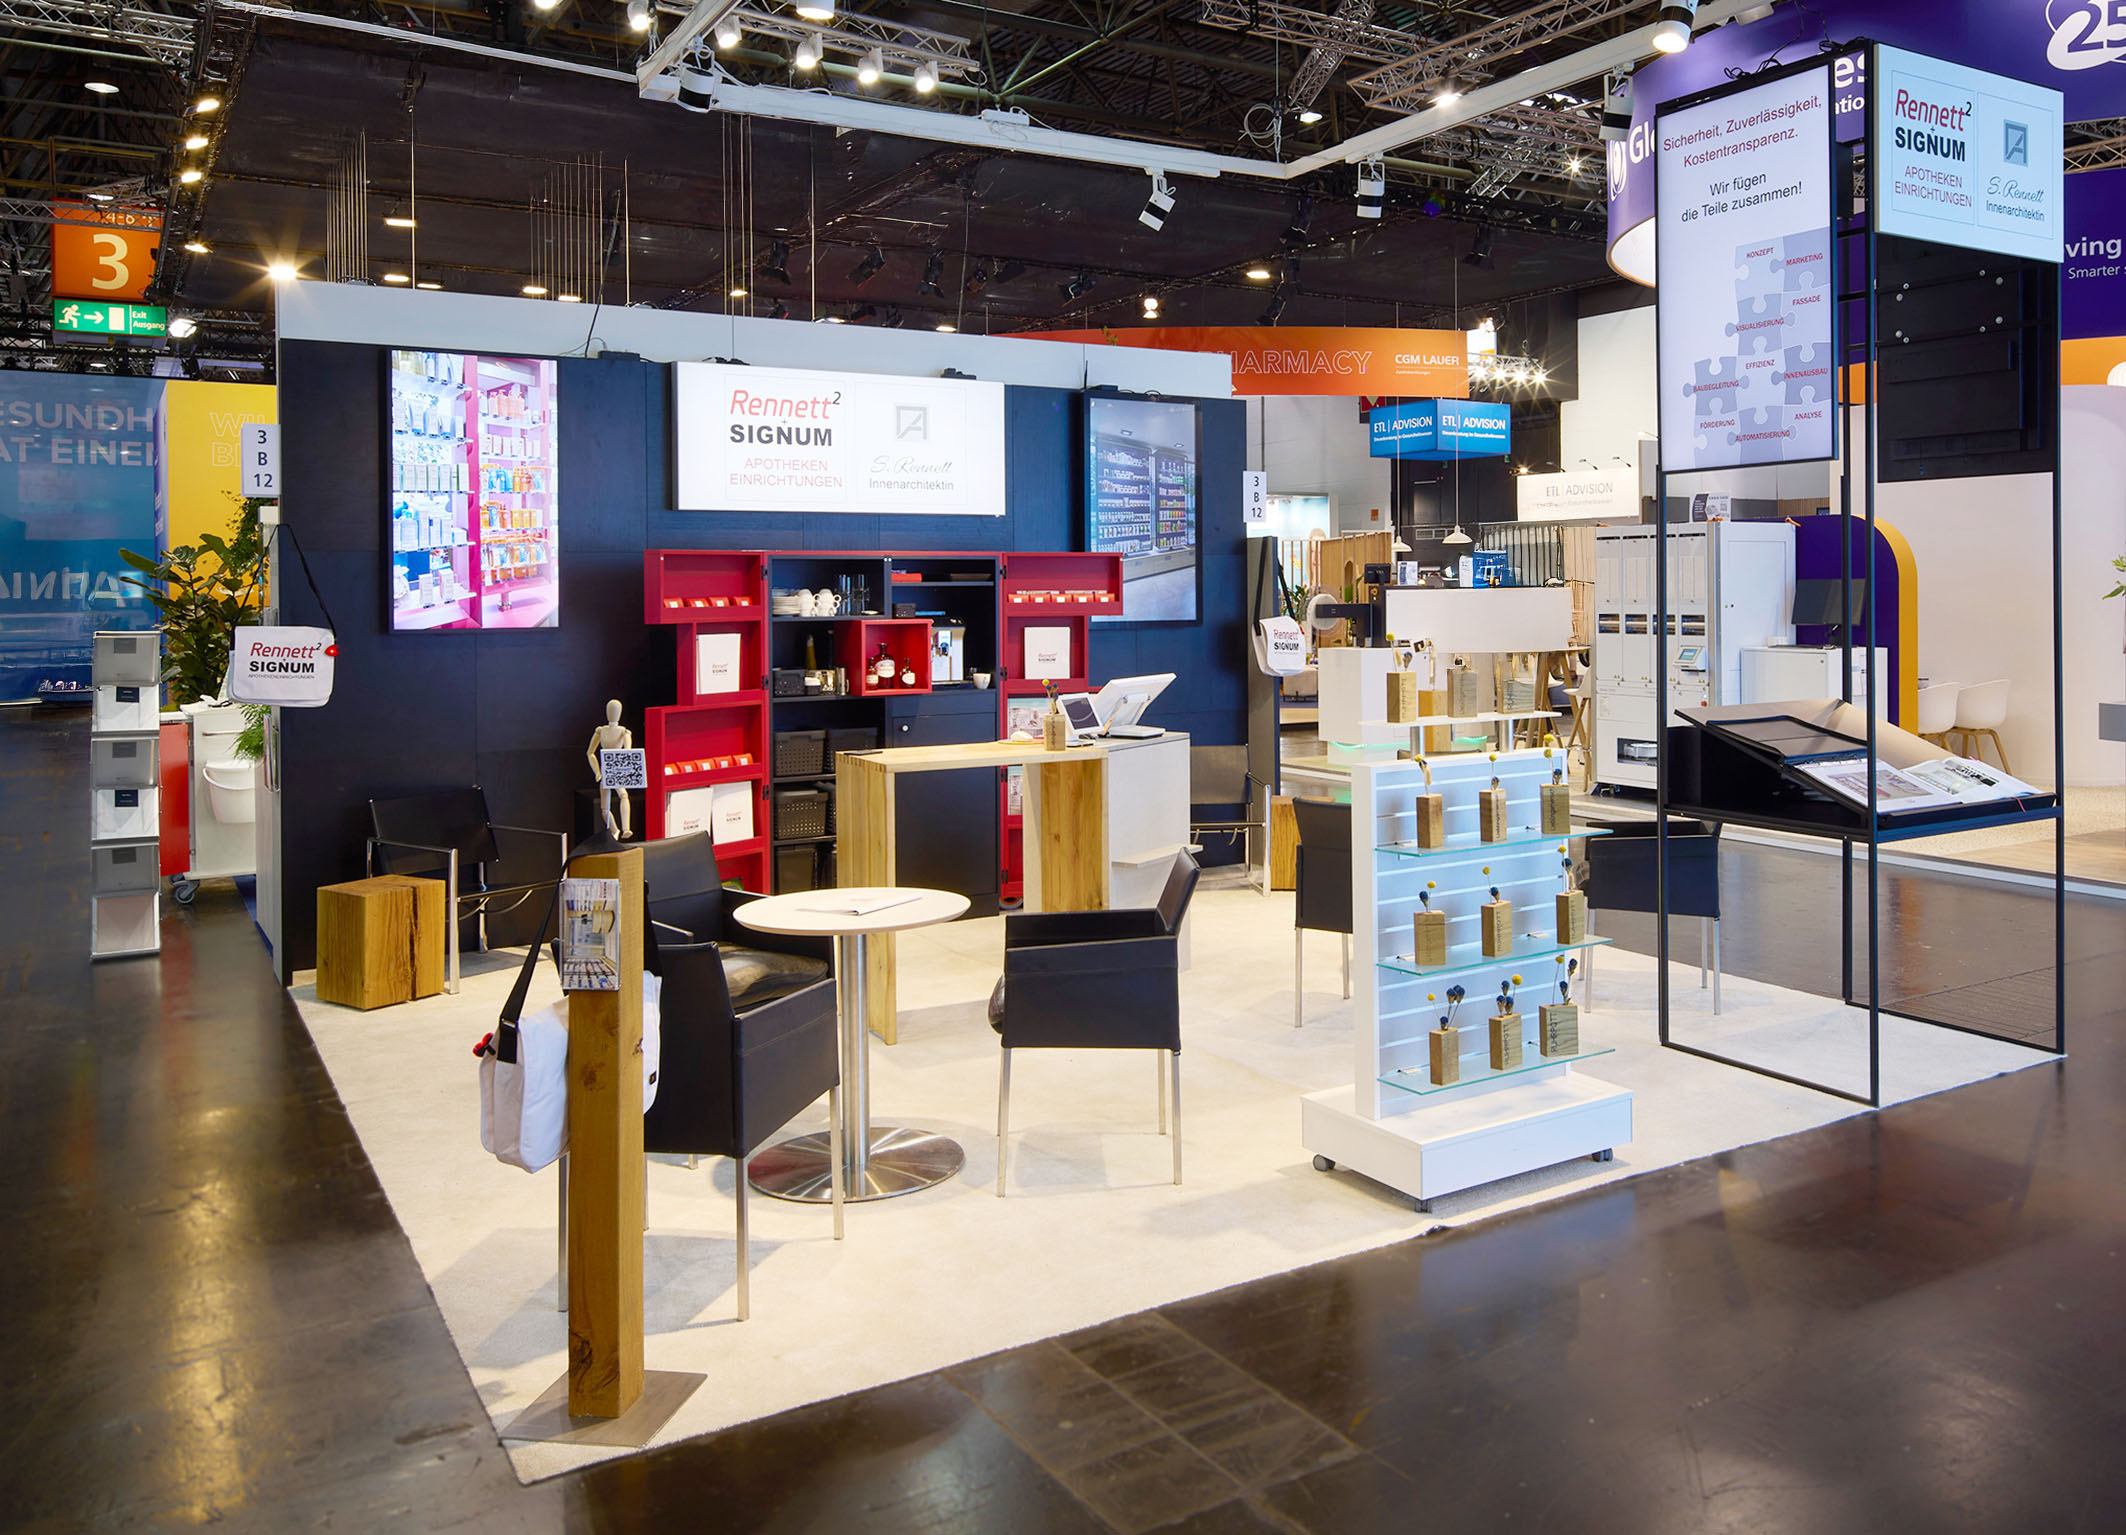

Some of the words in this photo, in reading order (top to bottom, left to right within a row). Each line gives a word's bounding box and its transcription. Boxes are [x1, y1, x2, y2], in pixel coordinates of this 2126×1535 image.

[1663, 125, 1723, 152] Sicherheit,
[1726, 95, 1822, 134] Zuverlässigkeit,
[1684, 127, 1798, 168] Kostentransparenz.
[1894, 126, 1966, 162] SIGNUM
[1904, 165, 1963, 188] APOTHEKEN
[1709, 183, 1730, 196] Wir
[1733, 173, 1767, 194] fügen
[1894, 181, 1973, 207] EINRICHTUNGEN
[1681, 209, 1698, 223] die
[1702, 201, 1728, 217] Teile
[1731, 181, 1803, 211] zusammen!
[1985, 200, 2045, 222] Innenarchitektin
[1746, 247, 1775, 259] KONZEPT
[1786, 252, 1823, 266] MARKETING
[92, 233, 129, 290] 3
[2068, 265, 2121, 279] Smarter
[1792, 294, 1821, 306] FASSADE
[132, 311, 147, 320] Exit
[133, 320, 165, 331] Ausgang
[1735, 317, 1785, 332] VISUALISIERUNG
[1395, 354, 1420, 364] CGM
[1423, 355, 1460, 366] LAUER
[1745, 359, 1775, 370] EFFIZIENZ
[1784, 367, 1828, 380] INNENAUSBAU
[1693, 380, 1739, 393] BAUBEGLEITUNG
[1442, 415, 1456, 426] ETL
[1463, 416, 1506, 430] ADVISION
[1795, 410, 1822, 421] ANALYSE
[1374, 422, 1386, 433] ETL
[1392, 416, 1432, 431] ADVISION
[1700, 419, 1735, 430] FÖRDERUNG
[257, 430, 267, 444] 3
[730, 424, 832, 447] SIGNUM
[1735, 429, 1790, 442] AUTOMATISIERUNG
[258, 452, 268, 466] B
[744, 458, 828, 472] APOTHEKEN
[254, 473, 272, 488] 12
[729, 472, 842, 488] EINRICHTUNGEN
[869, 478, 954, 490] Innenarchitektin
[1254, 476, 1260, 486] 3
[1566, 482, 1614, 496] ADVISION
[1252, 507, 1262, 518] 12
[1274, 642, 1300, 650] SIGNUM
[249, 660, 315, 674] SIGNUM
